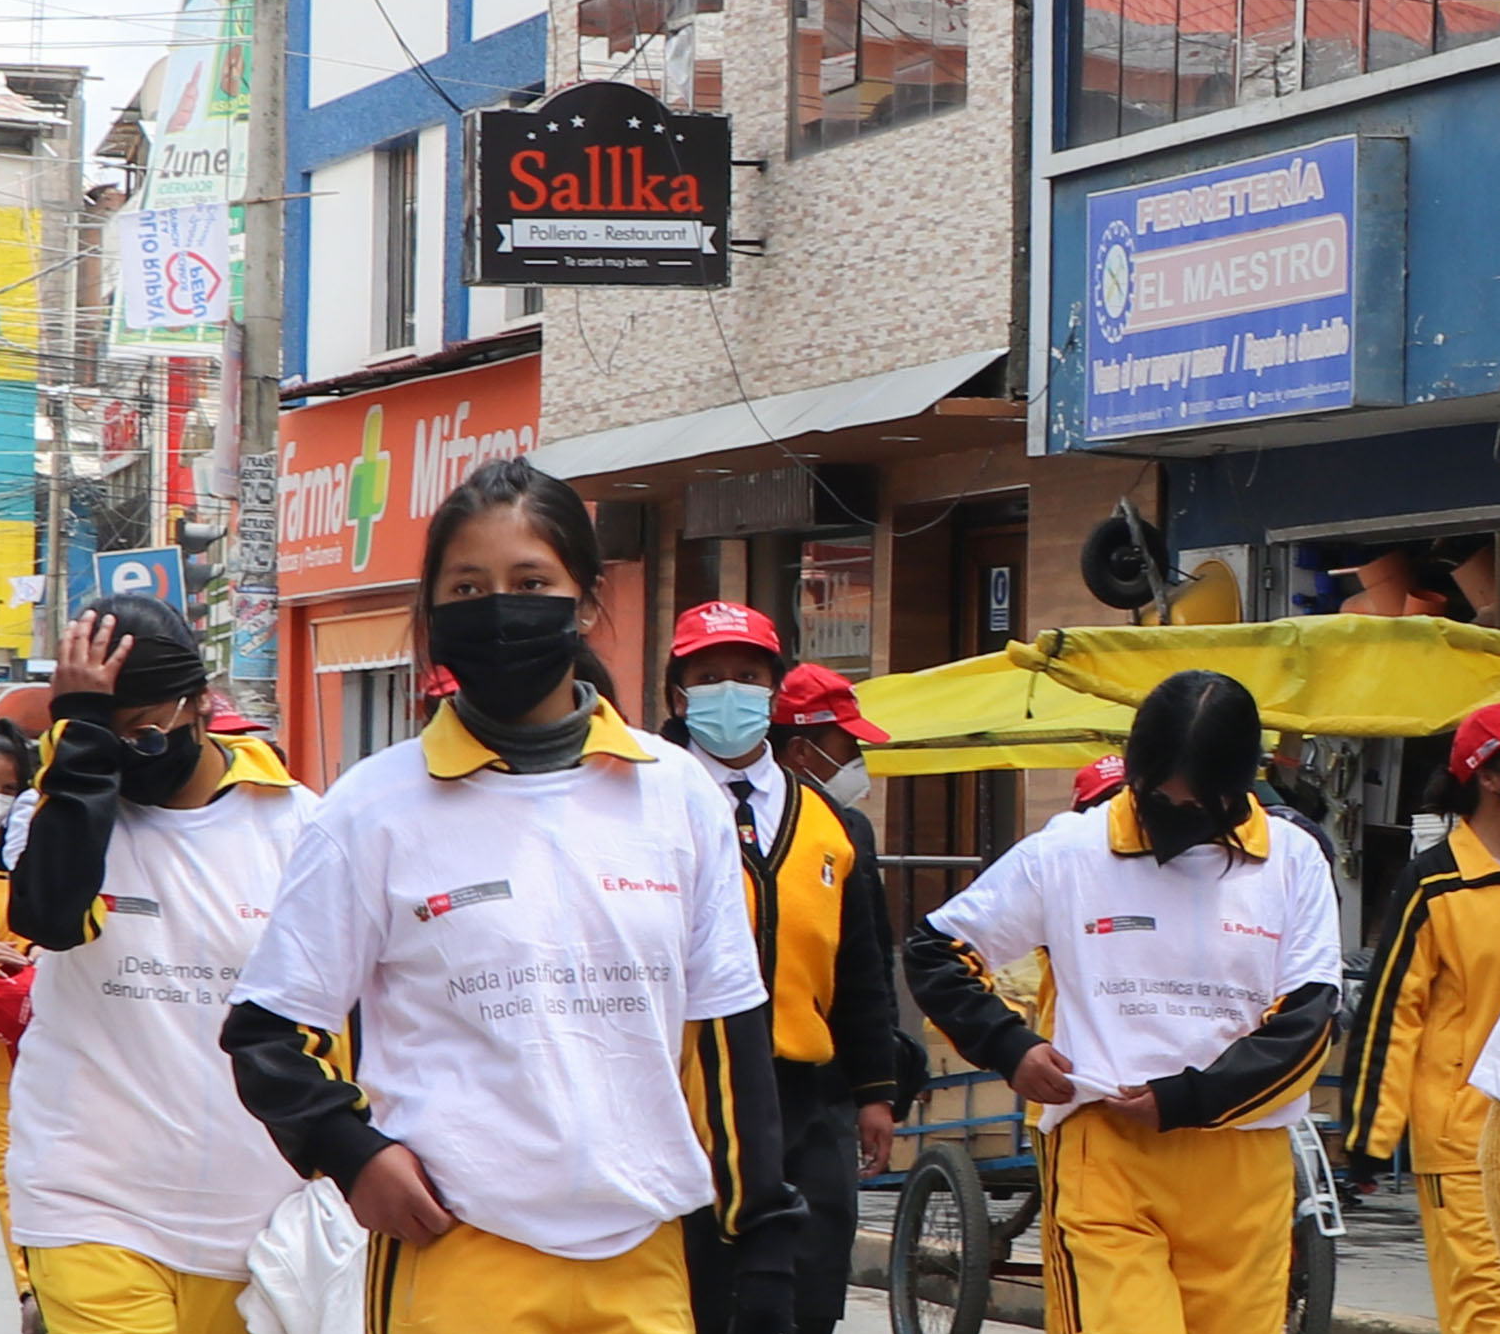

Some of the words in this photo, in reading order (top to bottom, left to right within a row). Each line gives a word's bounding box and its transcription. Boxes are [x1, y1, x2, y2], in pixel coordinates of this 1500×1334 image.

[509, 145, 704, 213] Sallka
[1136, 157, 1325, 236] FERRETERÍA
[605, 226, 687, 241] Restaurant
[1139, 272, 1175, 310] EL
[1183, 237, 1336, 304] MAESTRO
[117, 956, 214, 980] ¡Debemos
[445, 971, 501, 1002] ¡Nada
[506, 963, 577, 991] justifica
[581, 962, 598, 983] la
[602, 962, 671, 984] violencia
[101, 979, 191, 1004] denunciar
[196, 987, 212, 1005] la
[1094, 979, 1138, 998] ¡Nada
[1140, 979, 1194, 997] justifica
[1197, 980, 1212, 996] la
[480, 995, 534, 1023] hacia
[544, 993, 569, 1016] las
[1118, 1002, 1160, 1018] hacia
[1165, 1002, 1187, 1017] las
